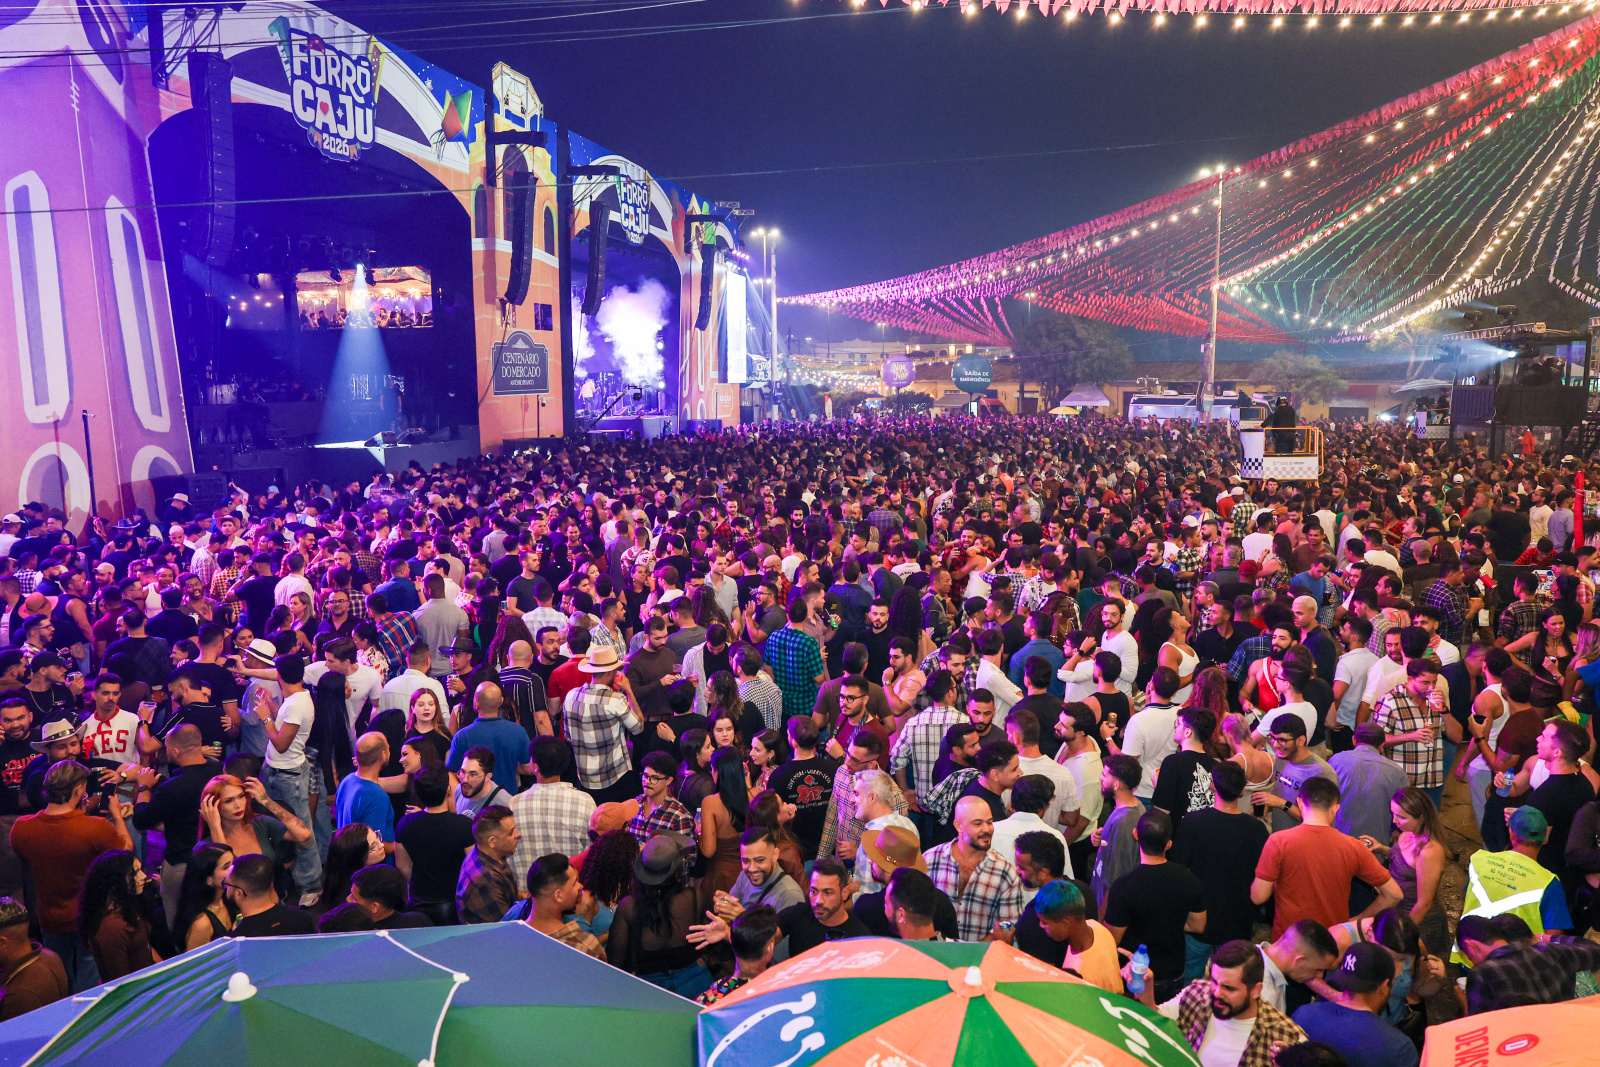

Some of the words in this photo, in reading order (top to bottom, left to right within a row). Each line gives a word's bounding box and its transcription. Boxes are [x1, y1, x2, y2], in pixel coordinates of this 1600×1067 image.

[290, 32, 371, 104] FORRÓ
[293, 79, 374, 144] CAJU
[322, 133, 350, 156] 2026
[621, 203, 649, 235] CAJU
[502, 351, 540, 364] CENTENÁRIO
[501, 366, 512, 378] DO
[512, 366, 541, 378] MERCADO
[964, 369, 981, 377] SAÍDA
